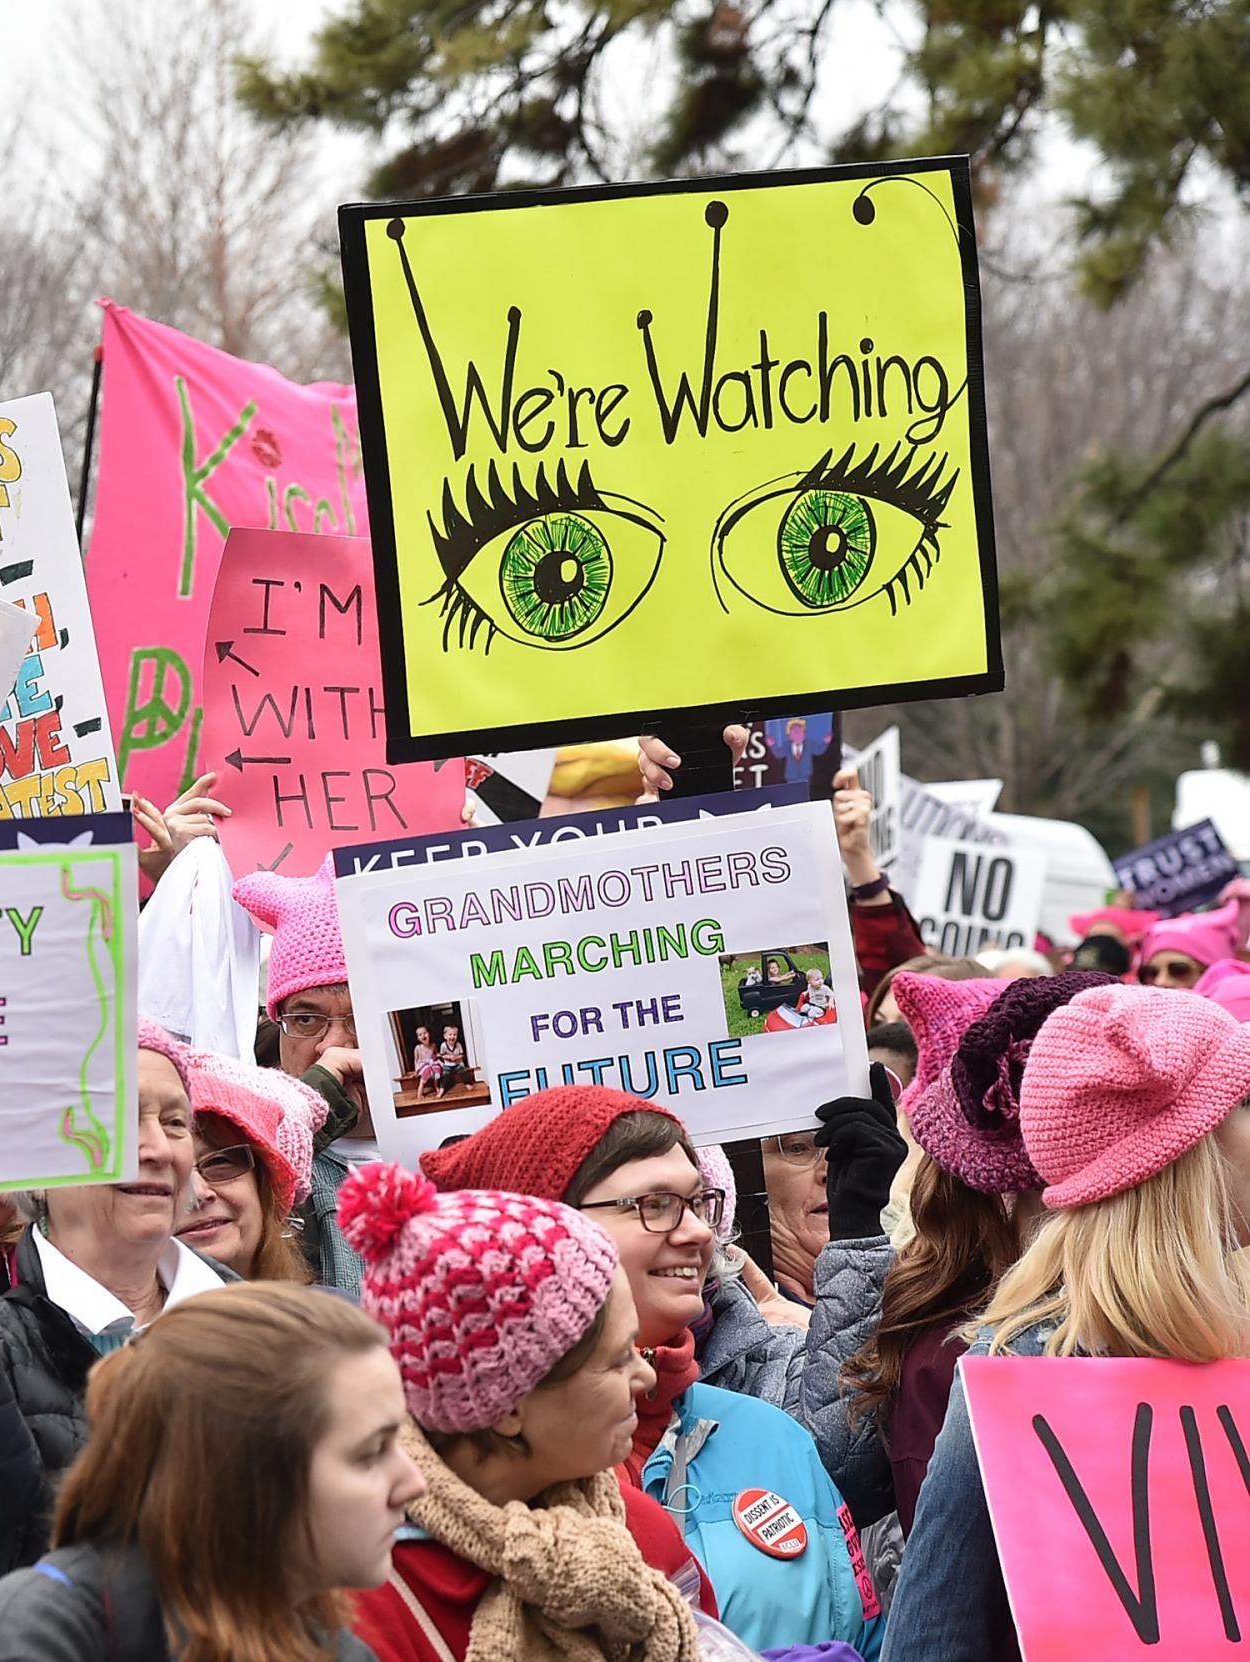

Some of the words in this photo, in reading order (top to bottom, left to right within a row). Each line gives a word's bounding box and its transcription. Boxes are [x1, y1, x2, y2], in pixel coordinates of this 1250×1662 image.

[387, 217, 631, 461] We're
[637, 197, 969, 446] Watching
[243, 578, 363, 645] I'M
[272, 768, 409, 831] HER
[388, 846, 792, 938] GRANDMOTHERS
[944, 851, 1014, 921] NO
[1117, 826, 1220, 892] TRUST
[470, 918, 725, 989] MARCHING
[530, 1006, 604, 1042] FOR
[612, 994, 685, 1029] THE
[743, 1499, 772, 1525] DISSENT
[769, 1494, 780, 1506] IS
[761, 1512, 795, 1541] PATRIOTIC
[1032, 1402, 1250, 1644] VI
